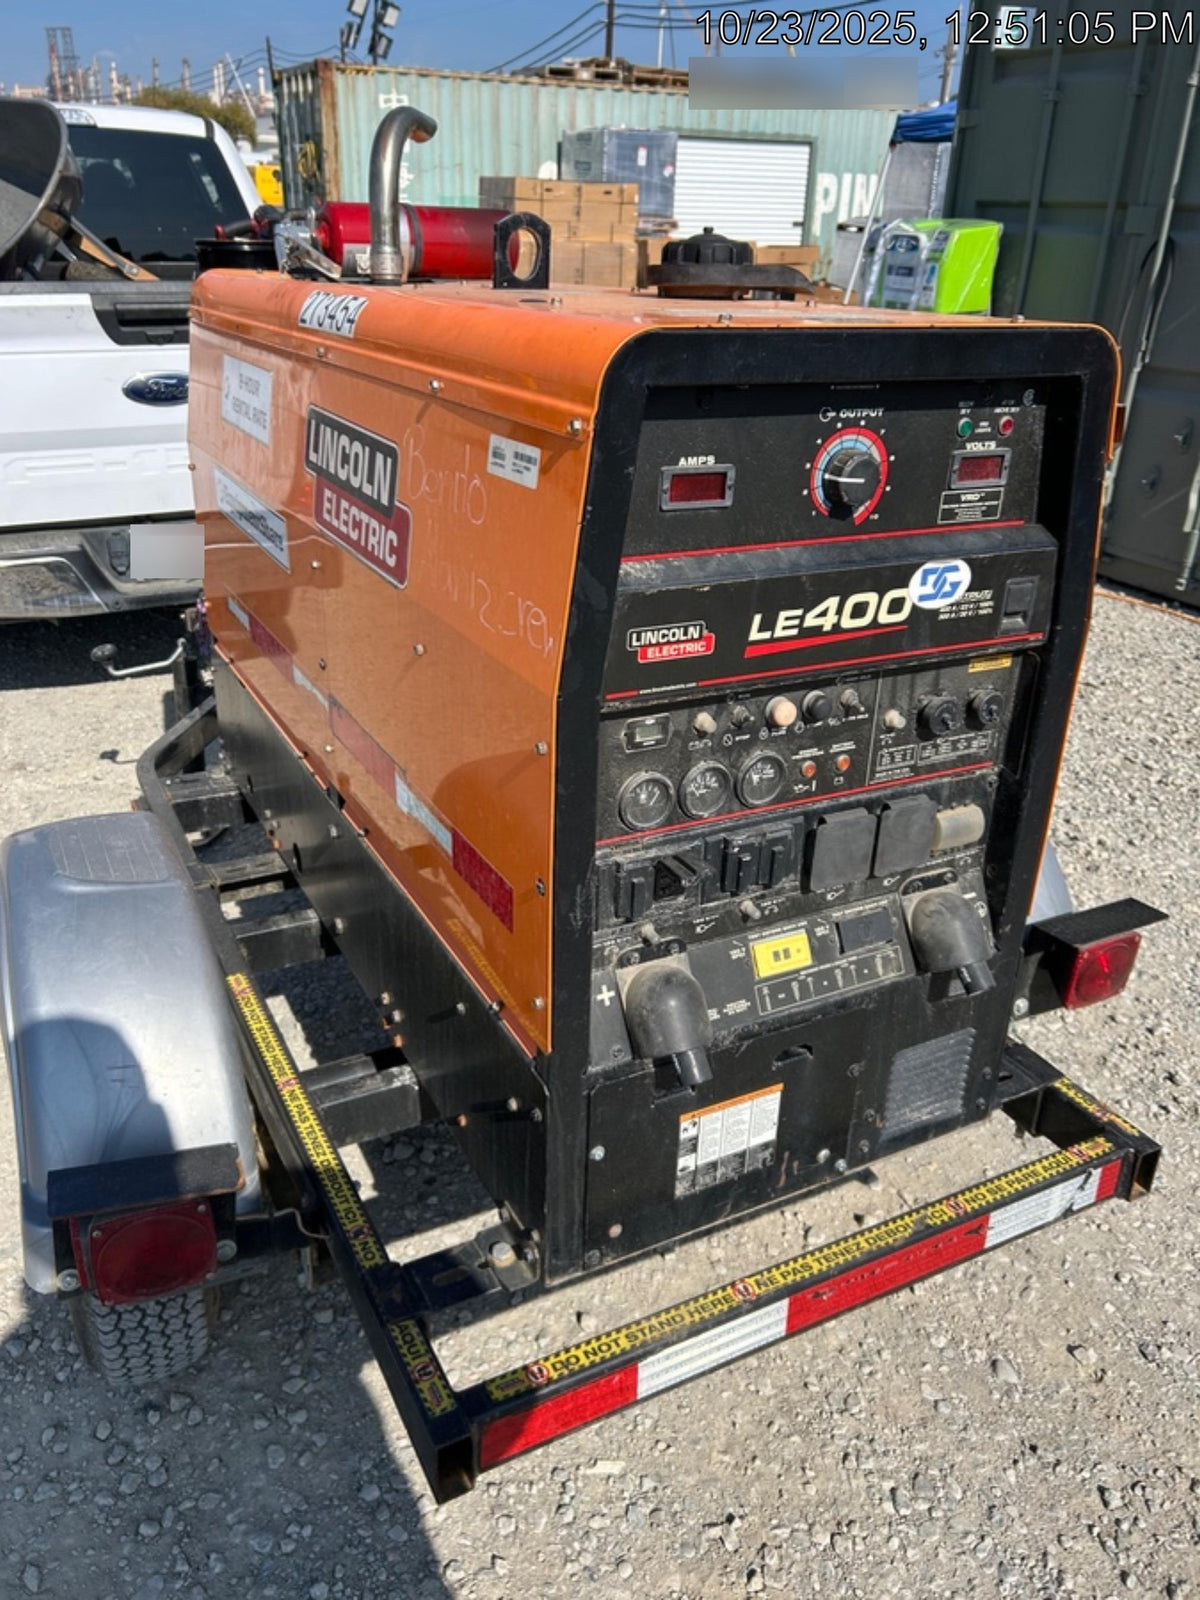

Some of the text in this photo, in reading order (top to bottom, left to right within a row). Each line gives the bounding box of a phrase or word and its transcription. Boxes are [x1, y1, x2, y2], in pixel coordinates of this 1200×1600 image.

[300, 291, 367, 335] 273454
[839, 408, 884, 418] OUTPUT
[308, 419, 393, 506] LINCOLN
[679, 455, 715, 466] AMPS
[965, 441, 996, 451] VOLTS
[322, 488, 399, 568] ELECTRIC
[632, 625, 701, 646] LINCOLN
[748, 588, 913, 641] LE400
[646, 641, 706, 659] ELECTRIC
[319, 1158, 350, 1205] DEBOUT
[963, 1155, 1073, 1207] NO SE PARE AQUI
[754, 1275, 777, 1290] NE
[779, 1262, 814, 1281] PAS
[815, 1243, 863, 1268] TENEZ
[360, 1240, 424, 1360] NO AQUI
[551, 1293, 735, 1372] DO NOT STAND HERE
